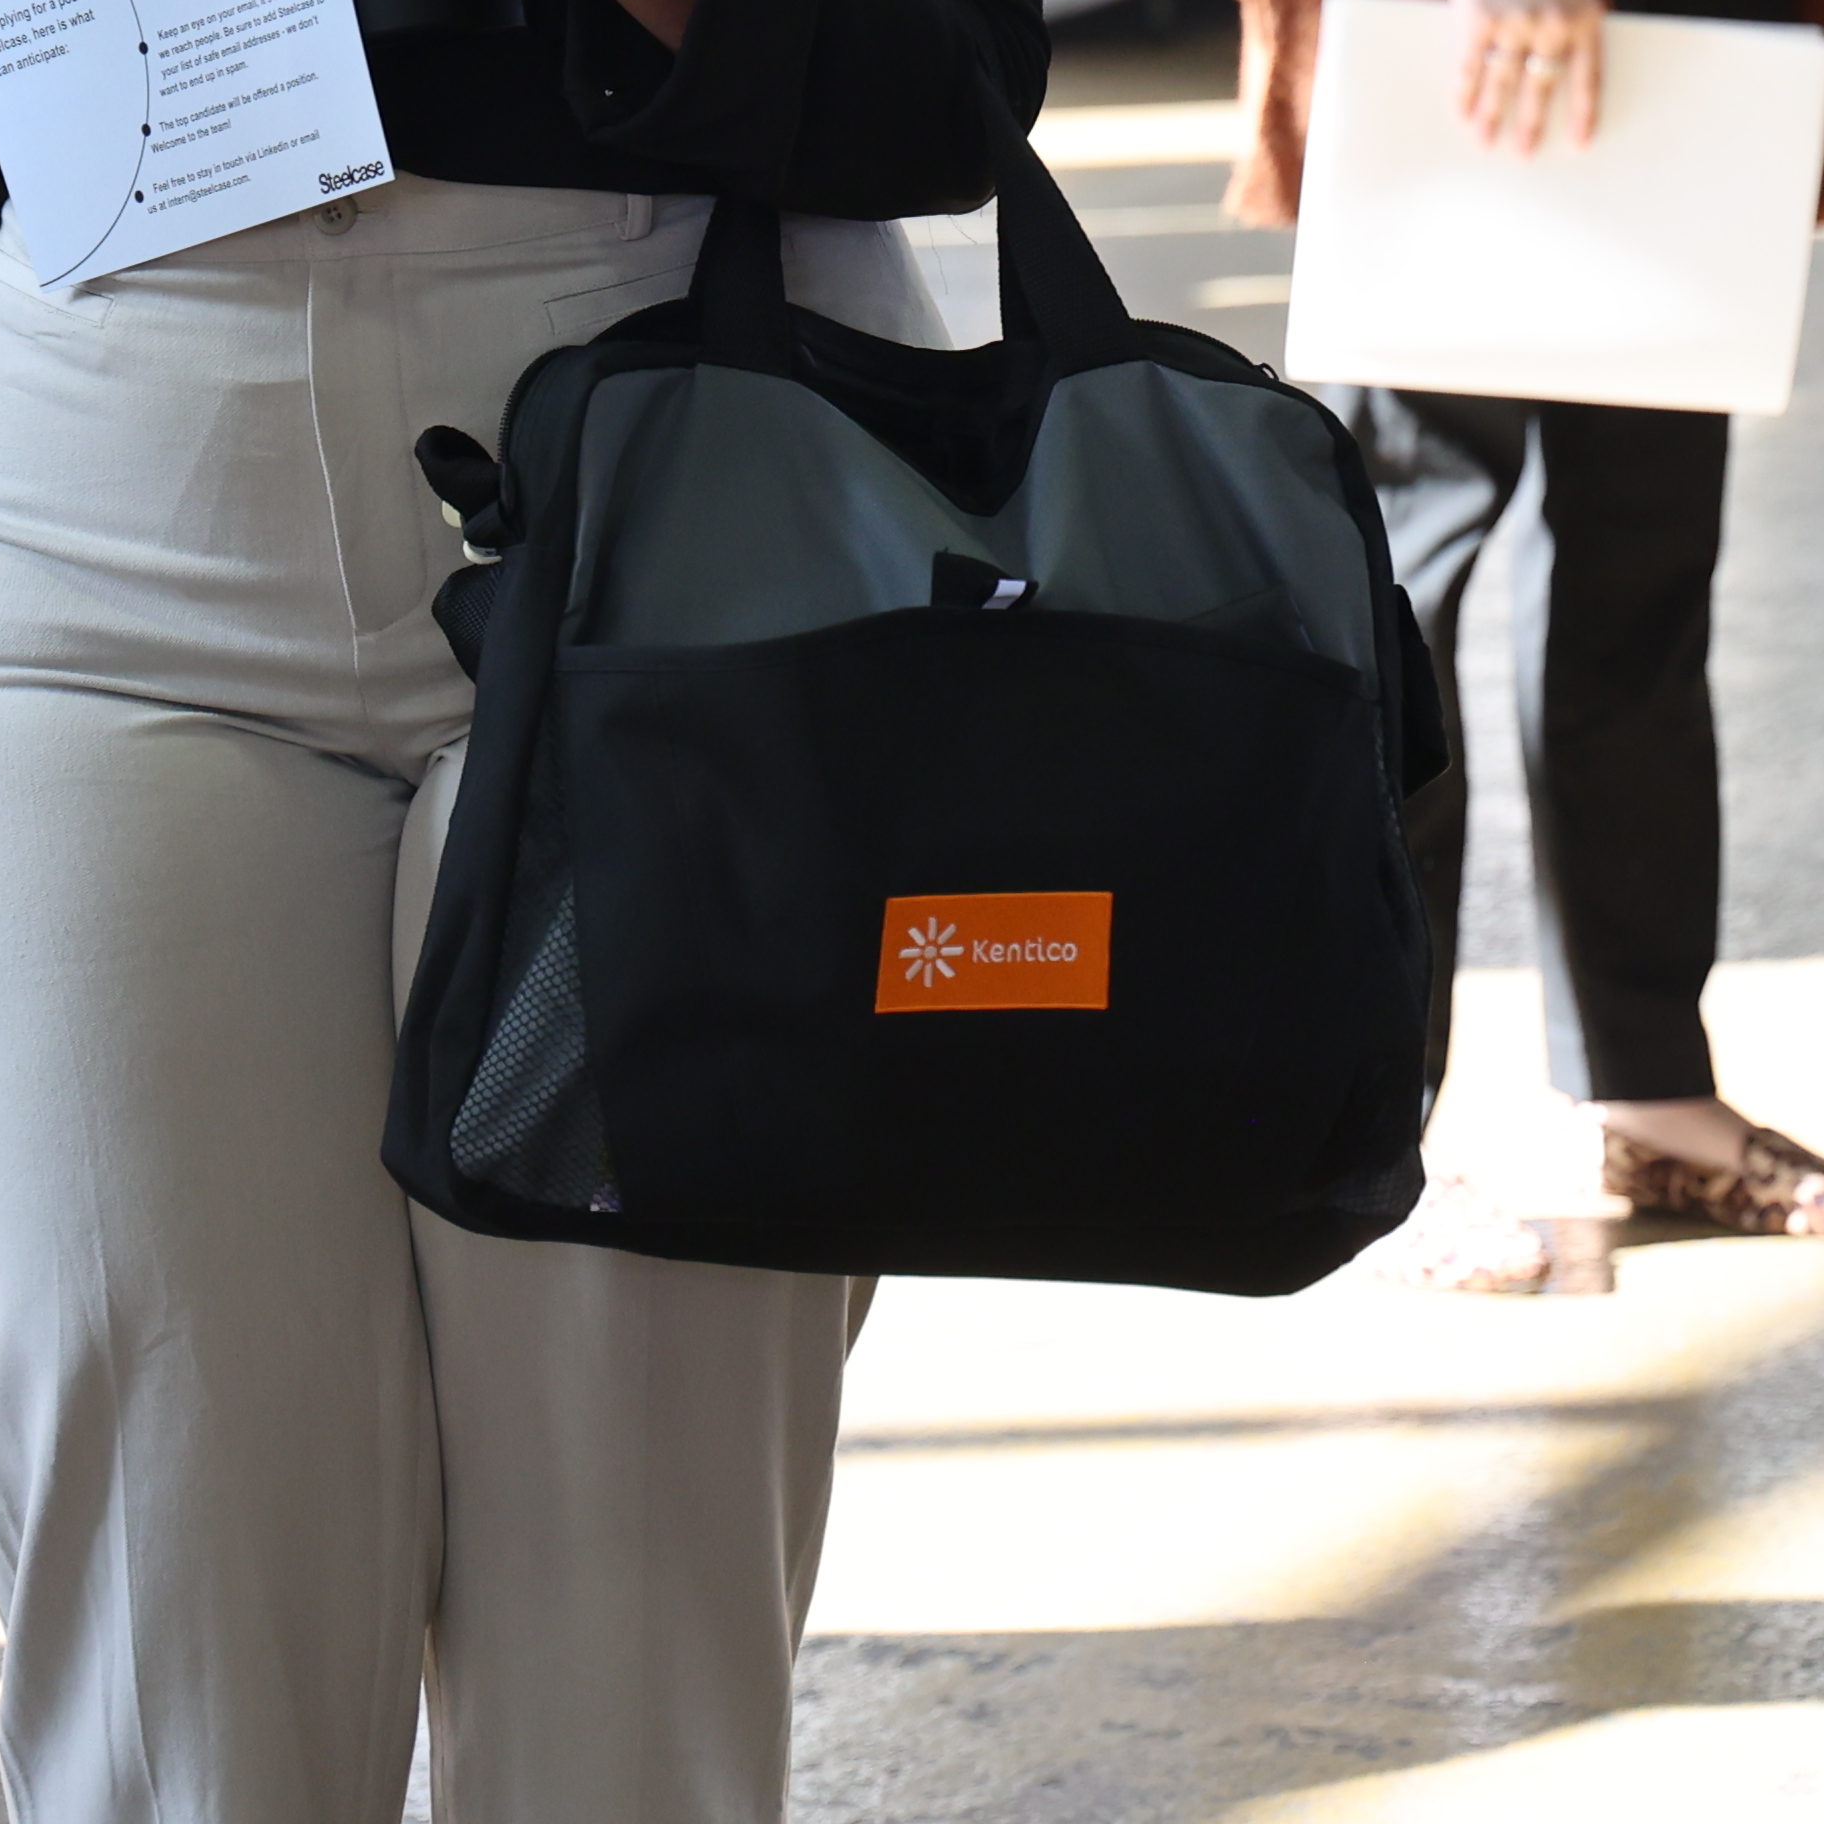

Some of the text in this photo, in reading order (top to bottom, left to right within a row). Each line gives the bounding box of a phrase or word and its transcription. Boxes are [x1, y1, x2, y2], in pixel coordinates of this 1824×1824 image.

[31, 2, 47, 15] for
[48, 0, 57, 9] a
[31, 24, 56, 39] here
[56, 19, 68, 31] is
[68, 8, 96, 26] what
[156, 27, 179, 40] Keep
[179, 23, 191, 33] an
[190, 18, 206, 30] eye
[206, 14, 217, 24] on
[217, 7, 235, 22] your
[157, 49, 171, 59] we
[170, 39, 194, 55] reach
[194, 31, 223, 49] people.
[222, 26, 235, 37] Be
[235, 20, 253, 33] sure
[252, 17, 262, 26] to
[262, 9, 278, 23] add
[160, 15, 319, 80] your list of safe email addresses we don't
[16, 44, 70, 69] anticipate:
[159, 61, 249, 96] want to end up in spam.
[158, 72, 319, 131] The top candidate will be offered a position.
[150, 118, 231, 153] Welcome to the team!
[152, 179, 170, 193] Feel
[170, 176, 187, 187] free
[186, 173, 196, 182] to
[196, 167, 213, 179] stay
[212, 164, 222, 173] in
[221, 155, 245, 170] touch
[244, 151, 257, 162] via
[290, 138, 298, 147] or
[299, 129, 320, 144] email
[318, 160, 385, 194] Steelcase
[146, 174, 252, 214] us at intern@steelcase.com.
[972, 937, 1078, 964] Kentico
